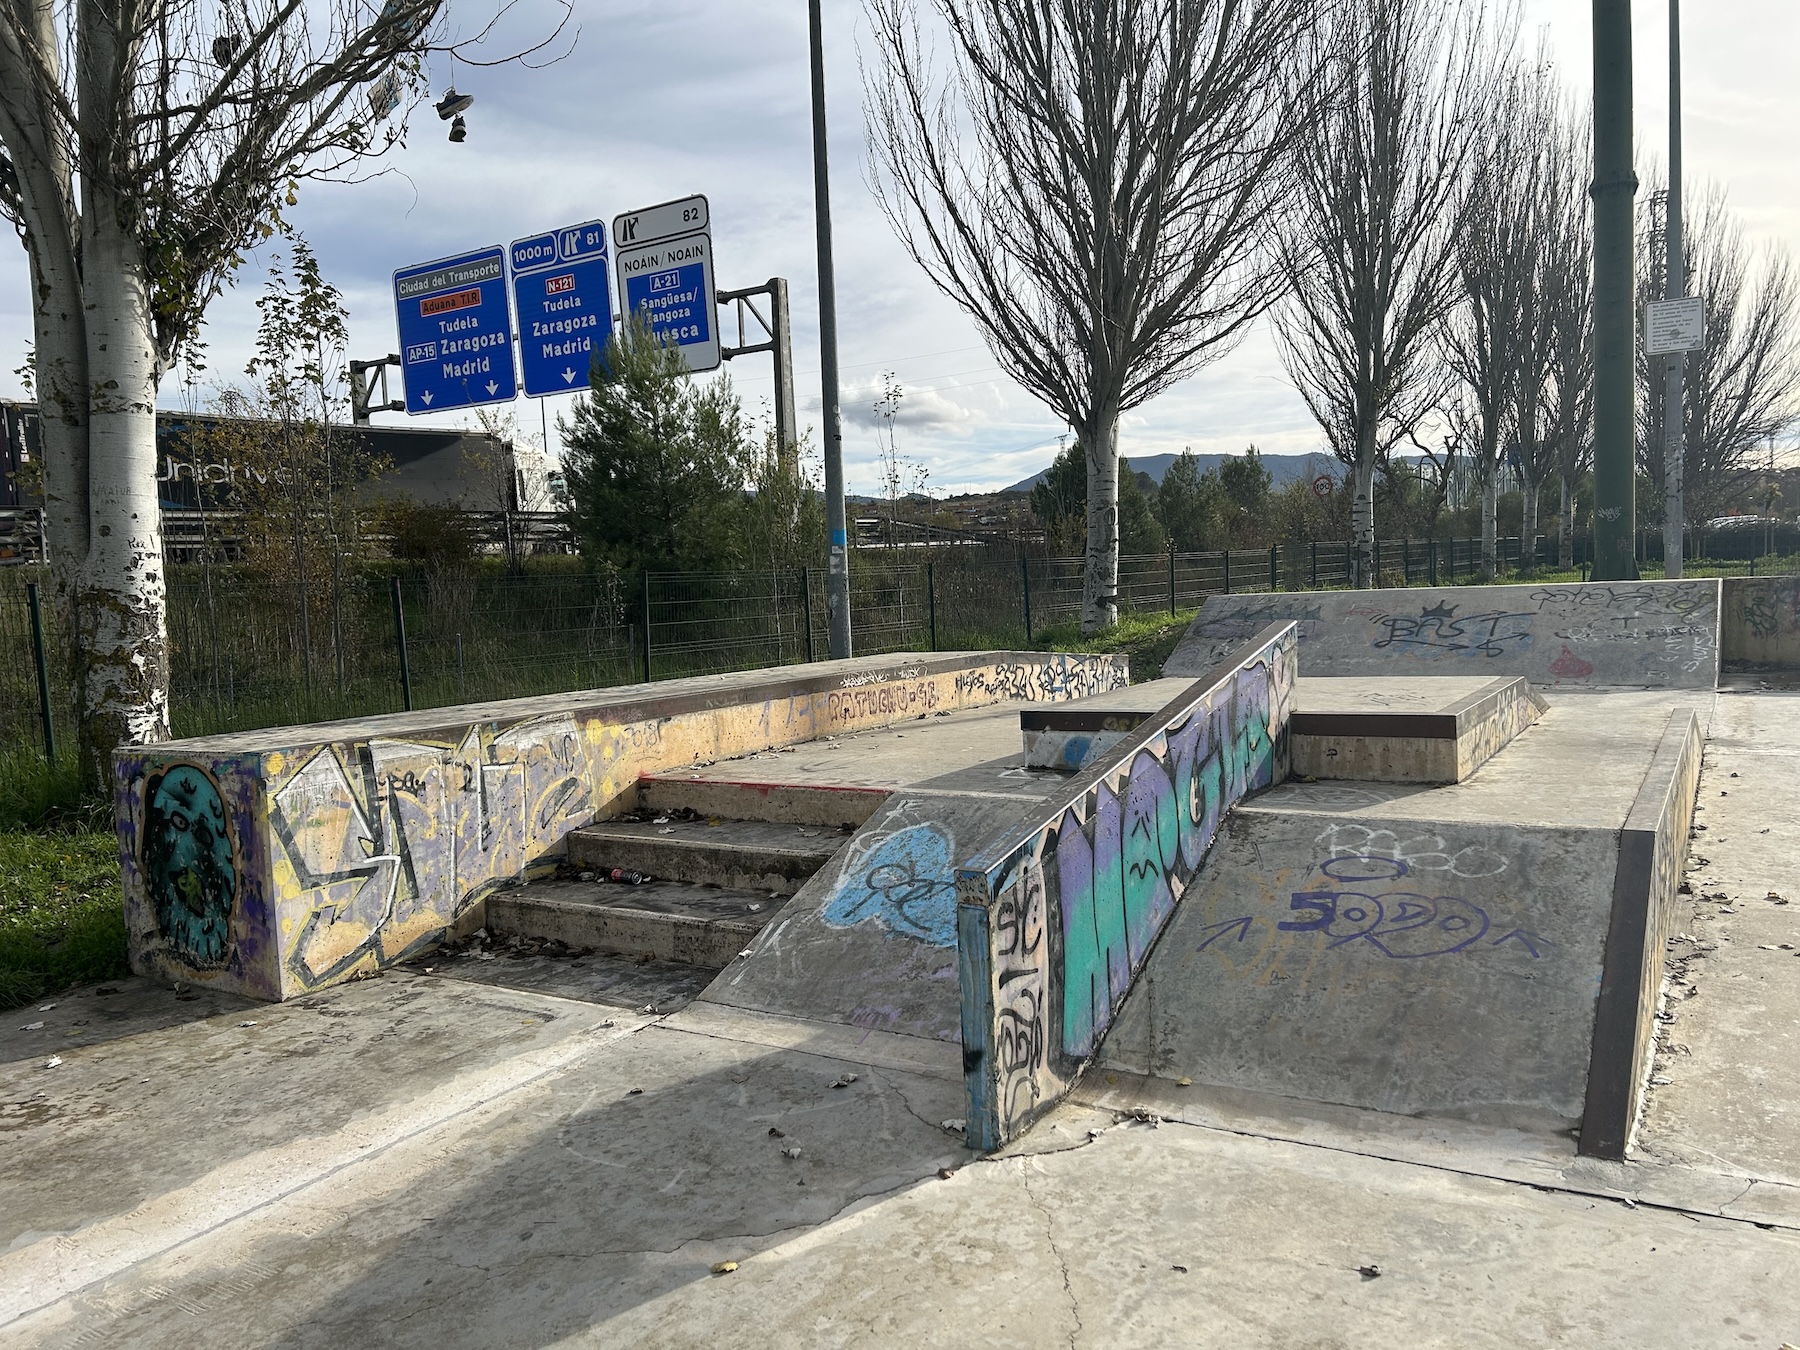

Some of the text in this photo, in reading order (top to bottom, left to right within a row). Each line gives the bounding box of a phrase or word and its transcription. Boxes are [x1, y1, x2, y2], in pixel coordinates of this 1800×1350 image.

[683, 207, 699, 222] 82
[586, 231, 599, 245] 81
[514, 246, 552, 262] 1000 m
[400, 263, 499, 294] Ciudad del Transporte
[548, 277, 573, 293] N-121
[653, 274, 677, 290] A-21
[422, 292, 480, 314] Aduana T.I.R.
[543, 296, 581, 313] Tudela
[439, 315, 478, 334] Tudela
[532, 314, 597, 337] Zaragoza
[652, 324, 699, 343] uesca
[440, 331, 505, 355] Zaragoza
[542, 336, 591, 359] Madrid
[409, 345, 435, 361] AP-15
[442, 356, 490, 379] Madrid
